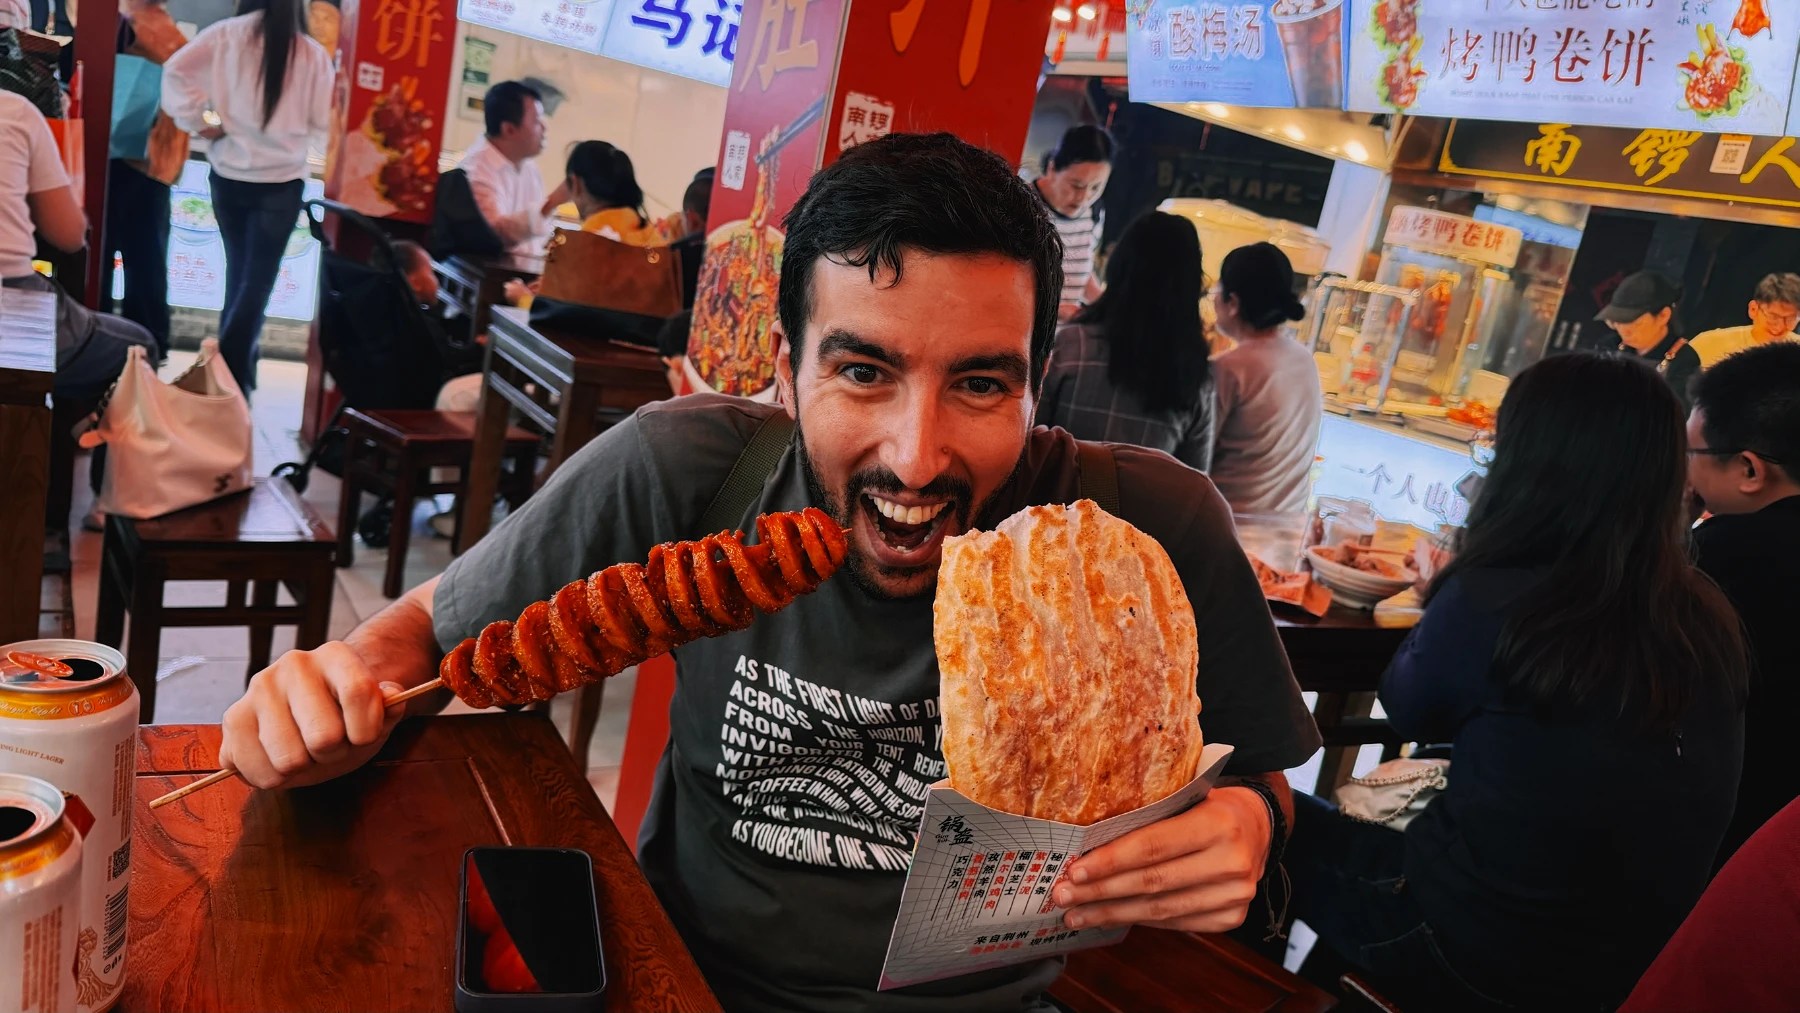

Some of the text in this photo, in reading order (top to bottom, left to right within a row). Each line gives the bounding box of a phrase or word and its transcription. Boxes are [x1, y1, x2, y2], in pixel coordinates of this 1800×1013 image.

[1167, 6, 1262, 60] 酸梅汤
[1439, 27, 1655, 87] 烤鸭卷饼
[729, 680, 813, 730] ACROSS
[822, 719, 863, 740] THE
[866, 725, 925, 747] HORIZON,
[734, 655, 758, 681] AS
[764, 663, 797, 700] THE
[794, 677, 849, 723] FIRST
[845, 693, 897, 725] LIGHT
[899, 703, 919, 721] OF
[15, 747, 40, 757] LIGHT
[40, 753, 65, 765] LAGER
[724, 701, 793, 741] FROM
[814, 735, 864, 750] YOUR
[876, 742, 905, 766] TENT,
[716, 762, 817, 780] MORNING
[814, 765, 854, 793] LIGHT.
[849, 785, 878, 815] WITH
[721, 743, 785, 766] WITH
[832, 756, 878, 787] BATHED
[870, 779, 889, 798] IN
[880, 789, 904, 812] THE
[897, 802, 925, 820] SOF
[747, 776, 812, 793] COFFEE
[805, 780, 826, 797] IN
[872, 756, 894, 778] THE
[731, 819, 753, 844] AS
[751, 821, 782, 858] YOU
[774, 825, 838, 868] BECOME
[834, 833, 874, 870] ONE
[947, 855, 969, 889] 巧克力
[974, 852, 1000, 898] 孜然羊肉
[984, 851, 1016, 910] 奥尔良鸡肉
[1004, 851, 1032, 896] 榴莲芝士
[1019, 851, 1047, 895] 紫薯芋泥
[1034, 852, 1063, 895] 秘制辣条
[974, 930, 1030, 945] 来自荆州
